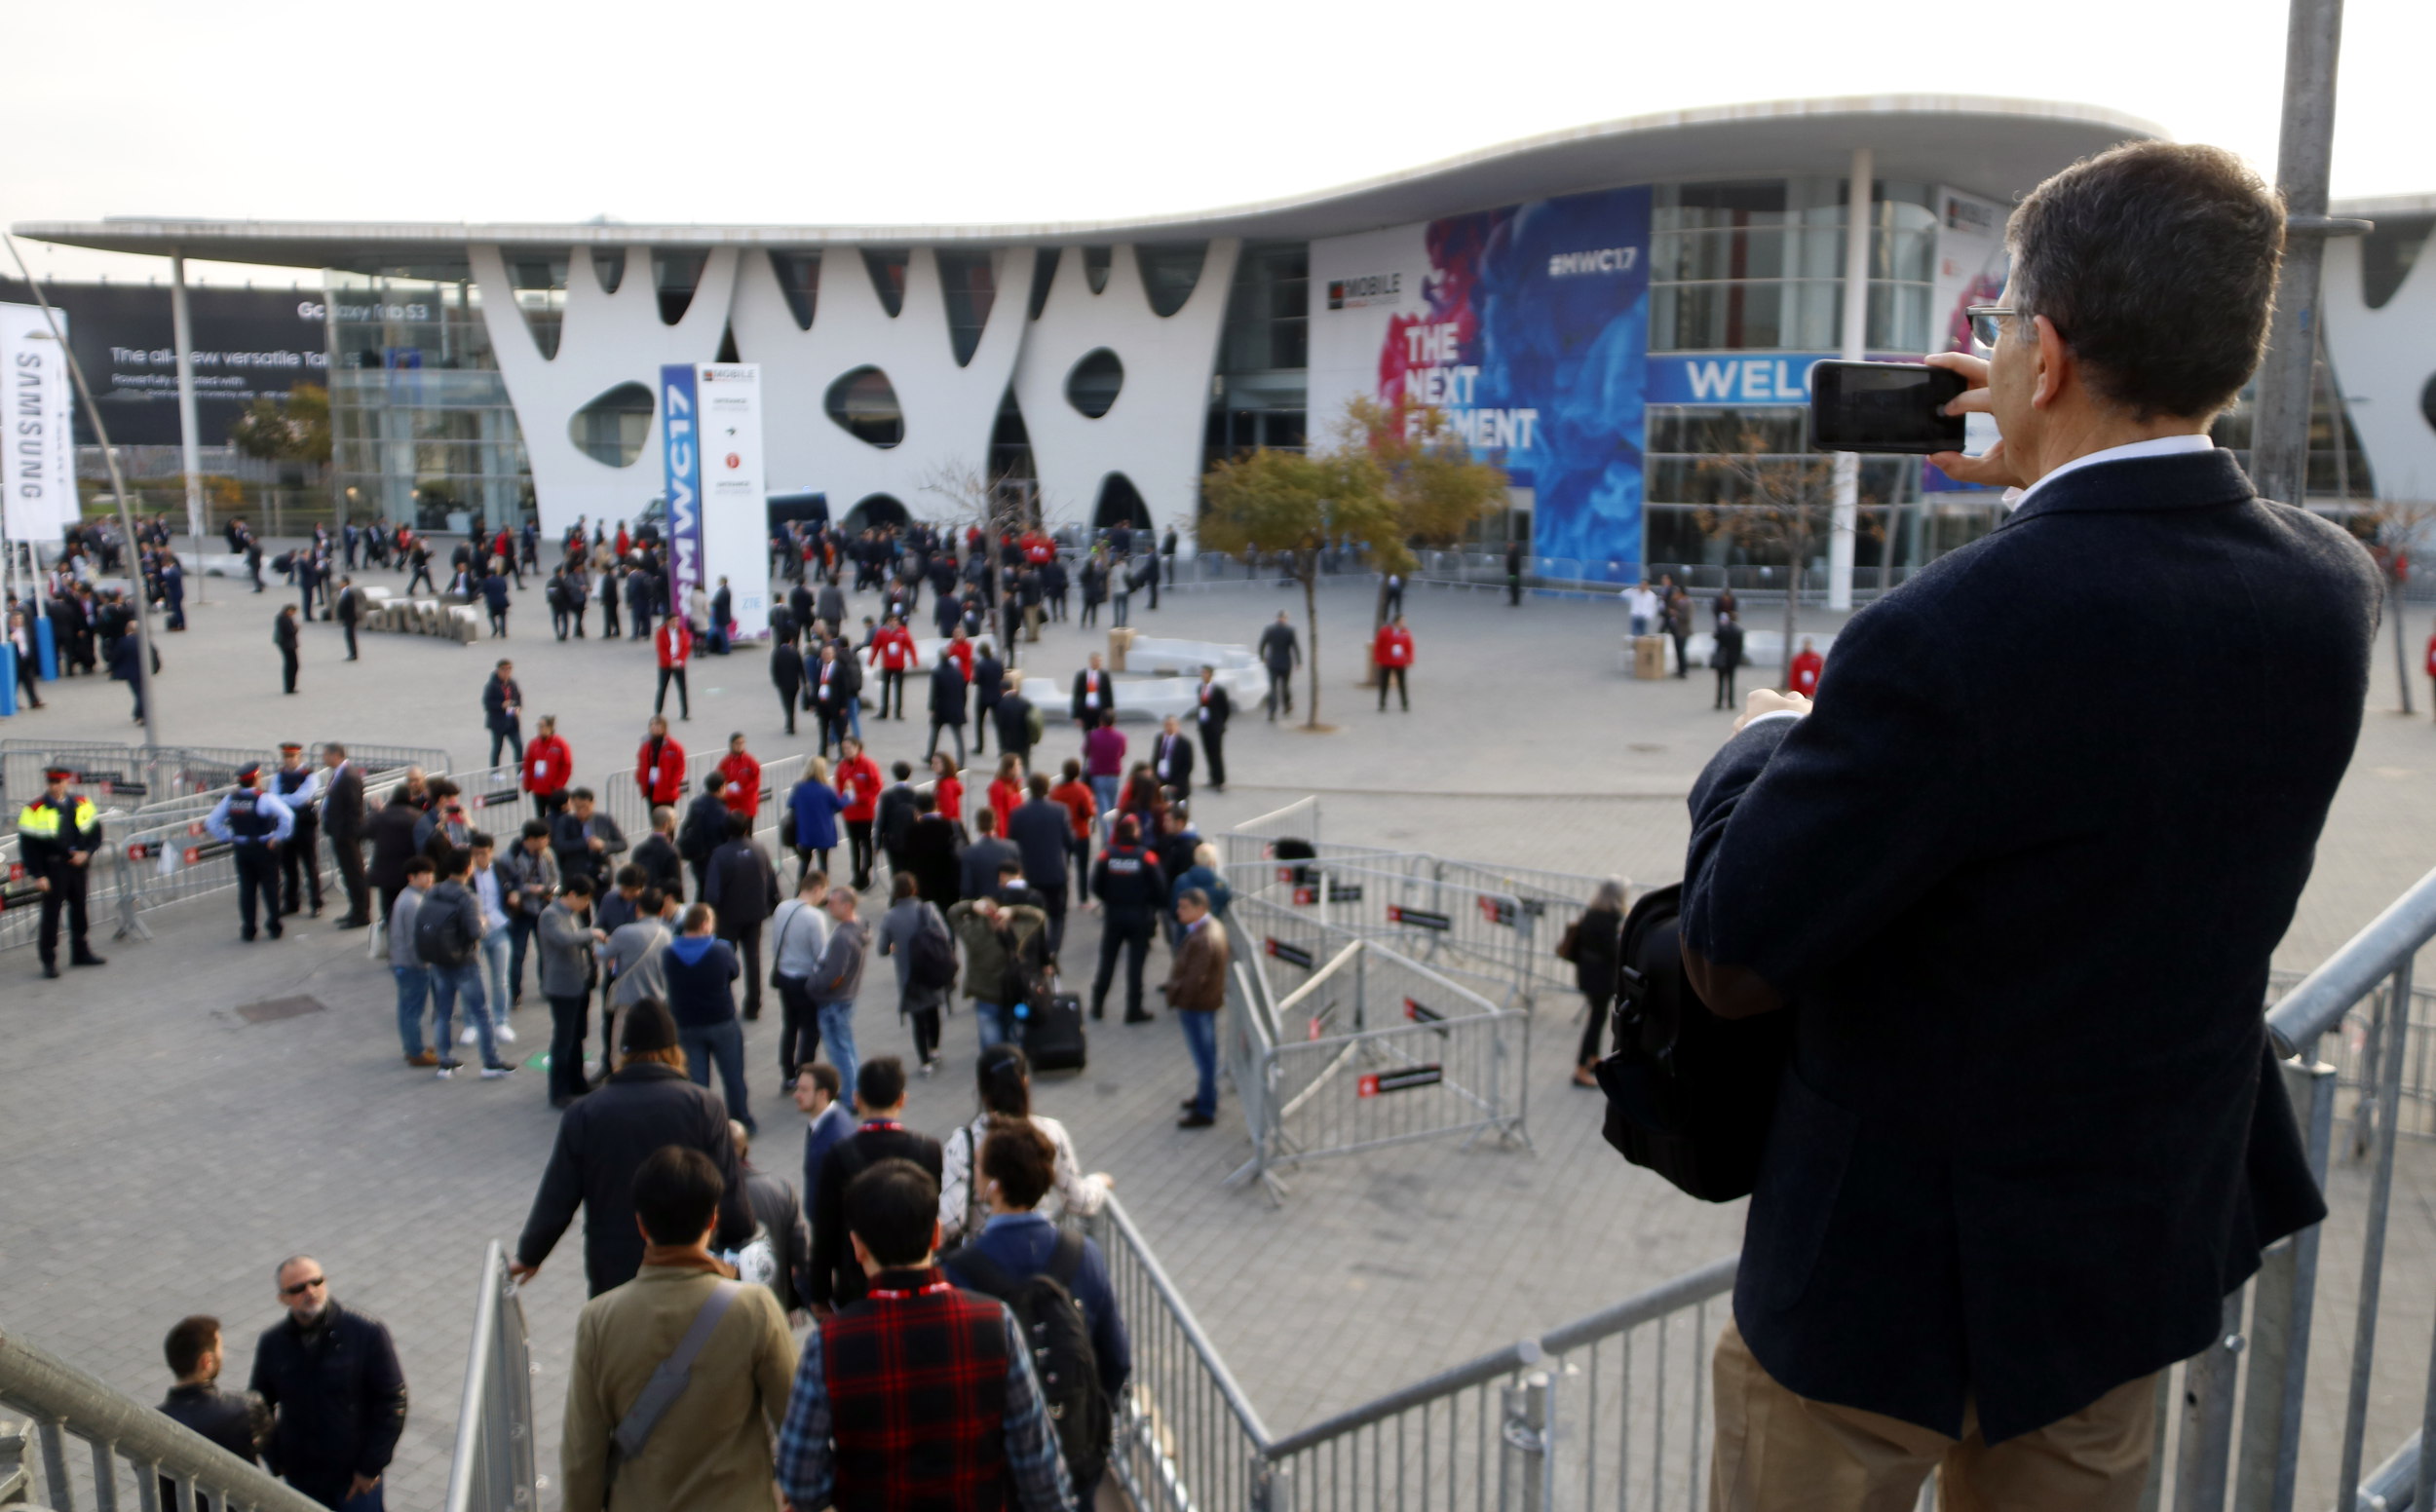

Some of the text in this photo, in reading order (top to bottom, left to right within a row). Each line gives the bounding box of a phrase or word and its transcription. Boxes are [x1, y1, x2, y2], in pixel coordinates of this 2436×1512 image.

[1549, 246, 1638, 277] #MWC17
[109, 346, 145, 365] The
[149, 349, 219, 366] all-ew
[222, 350, 301, 368] versatile
[1404, 321, 1460, 364] THE
[1404, 364, 1479, 405] NEXT
[16, 351, 43, 499] SAMSUNG
